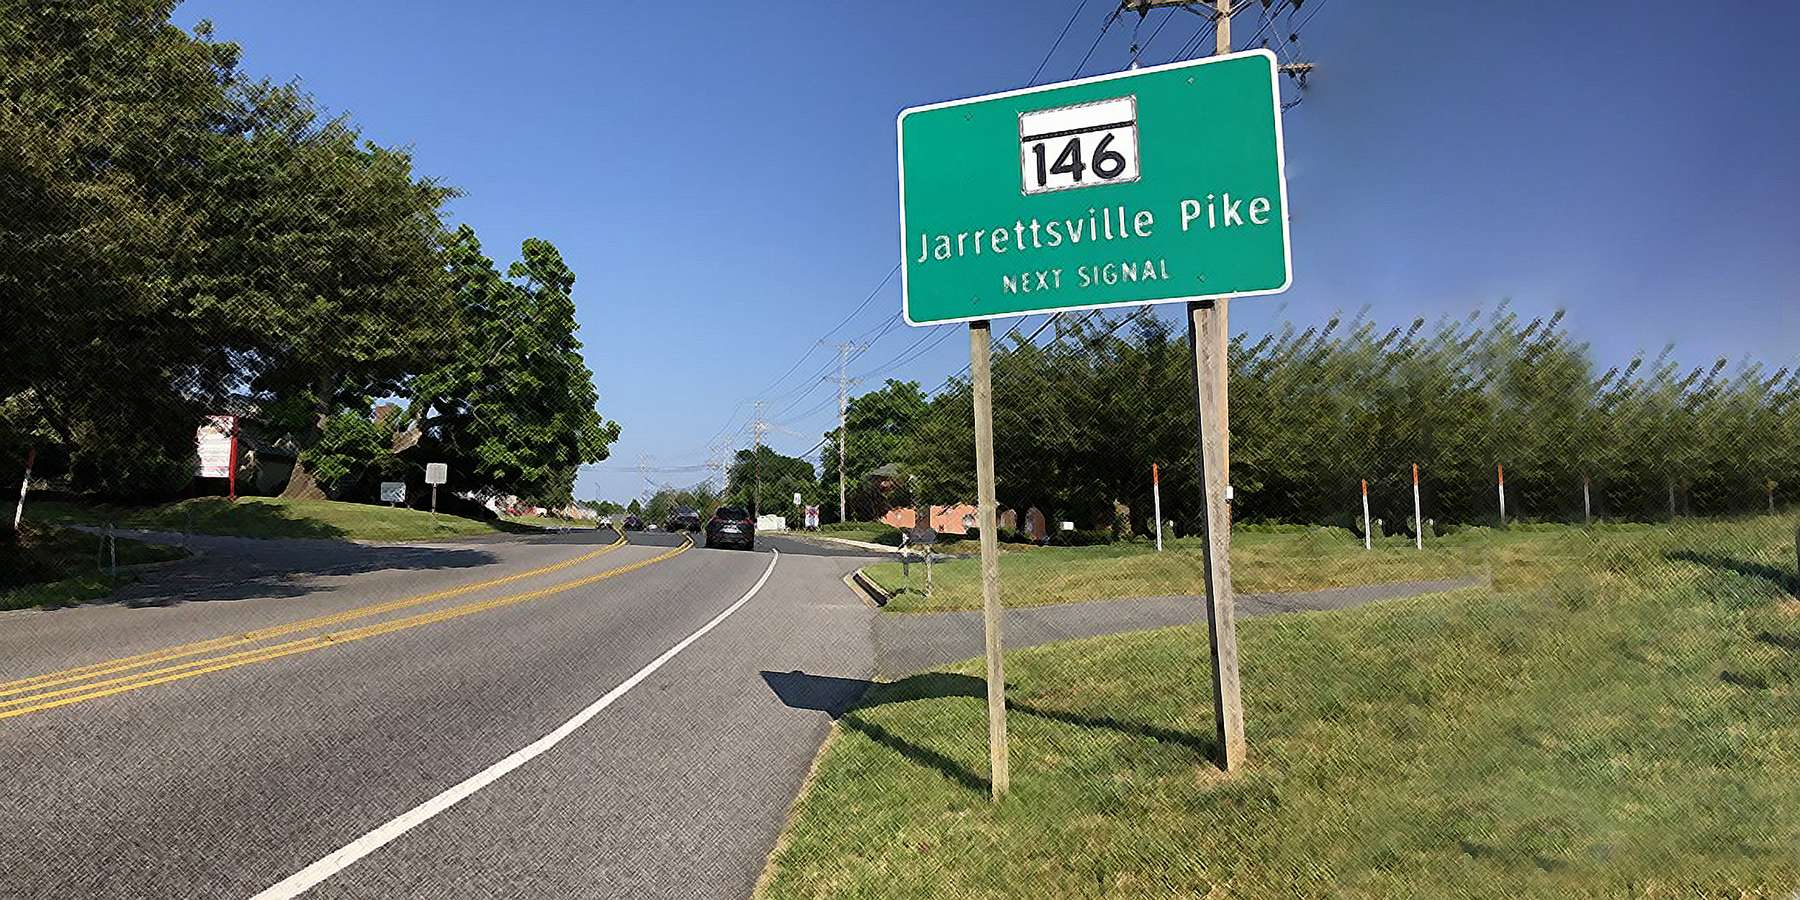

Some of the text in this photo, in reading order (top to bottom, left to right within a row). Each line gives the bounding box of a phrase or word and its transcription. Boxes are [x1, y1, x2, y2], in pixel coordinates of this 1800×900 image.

[1032, 133, 1126, 187] 146
[918, 193, 1271, 263] Jarrettsville Pike
[1003, 259, 1170, 295] NEXT SIGNAL
